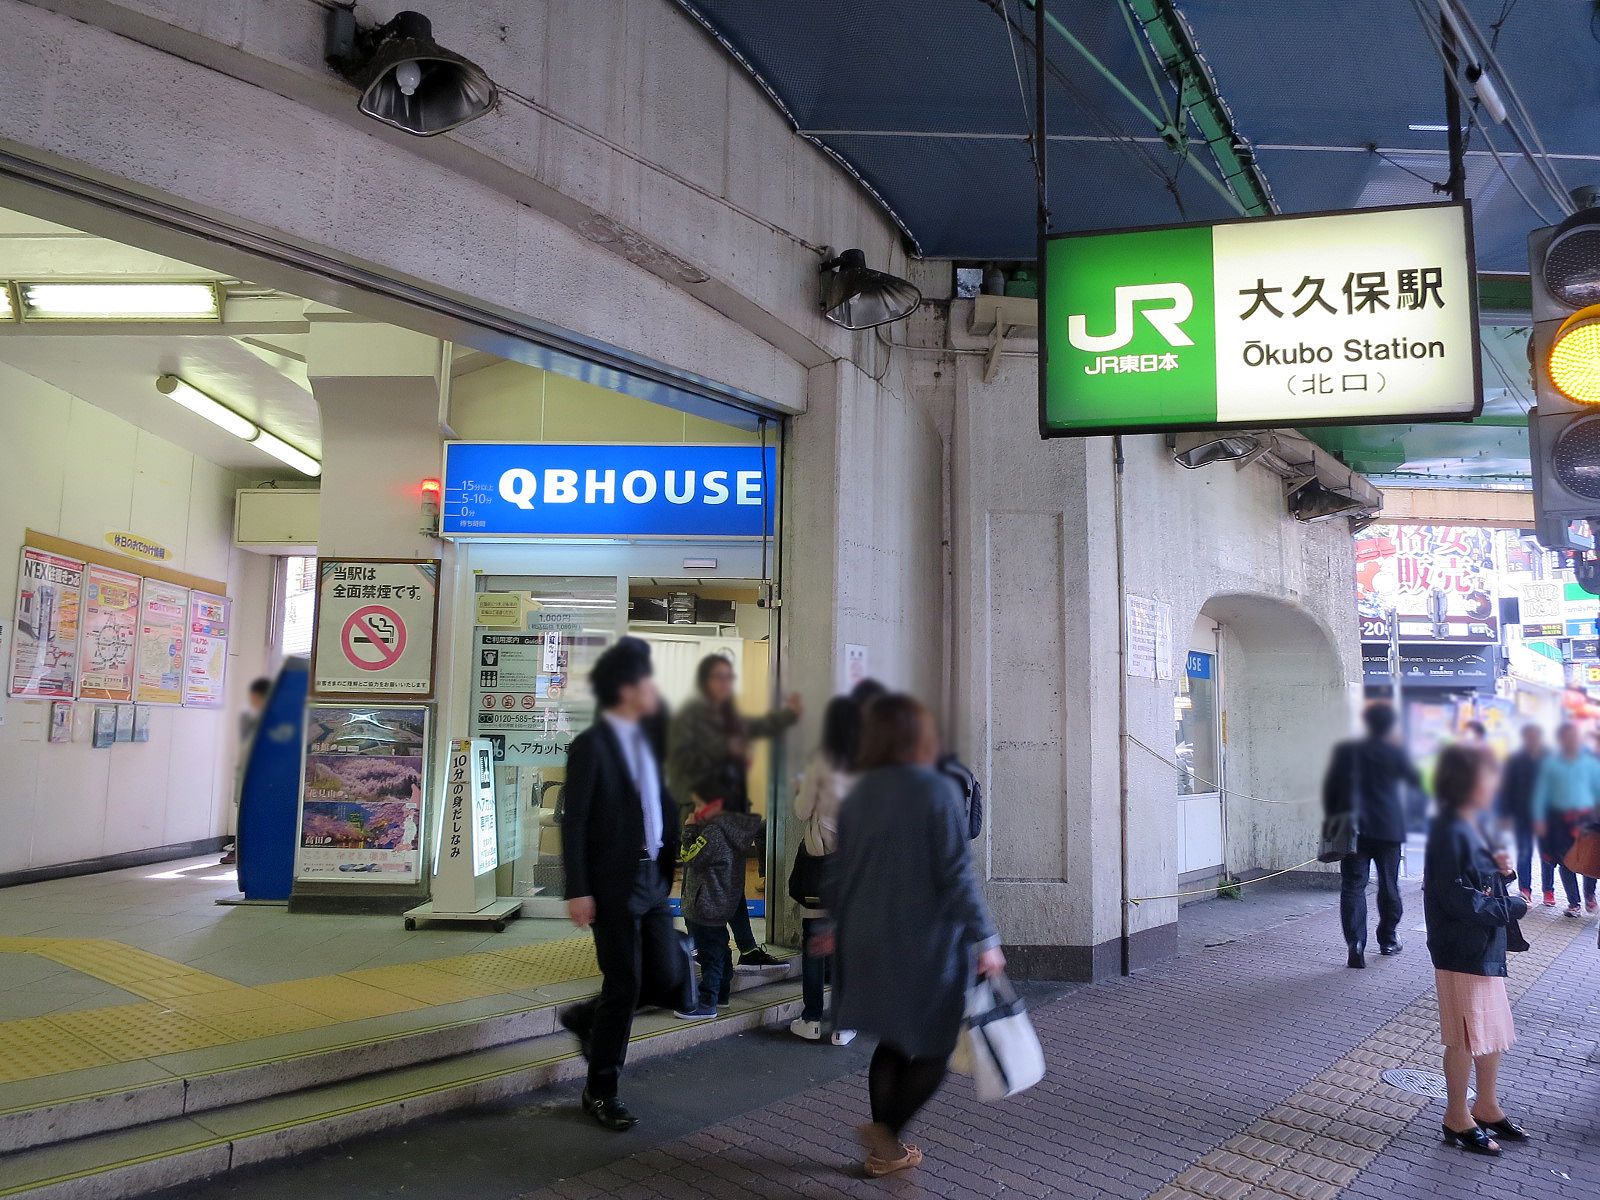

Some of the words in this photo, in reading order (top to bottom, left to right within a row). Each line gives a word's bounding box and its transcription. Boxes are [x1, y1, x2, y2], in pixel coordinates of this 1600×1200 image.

[1239, 267, 1446, 321] 大久保駅
[1067, 282, 1195, 352] JR
[1242, 340, 1334, 367] Ōkubo
[1343, 337, 1446, 362] Station
[1083, 352, 1180, 376] JR東日本
[461, 493, 492, 505] 5-10分
[461, 506, 476, 517] 0分
[459, 519, 486, 528] 待ち時間
[333, 566, 376, 581] 当駅は
[1397, 557, 1472, 592] 販売
[333, 583, 422, 602] 全面禁煙です。
[485, 636, 520, 644] ご利用案内
[449, 754, 468, 859] 10分の身だしなみ
